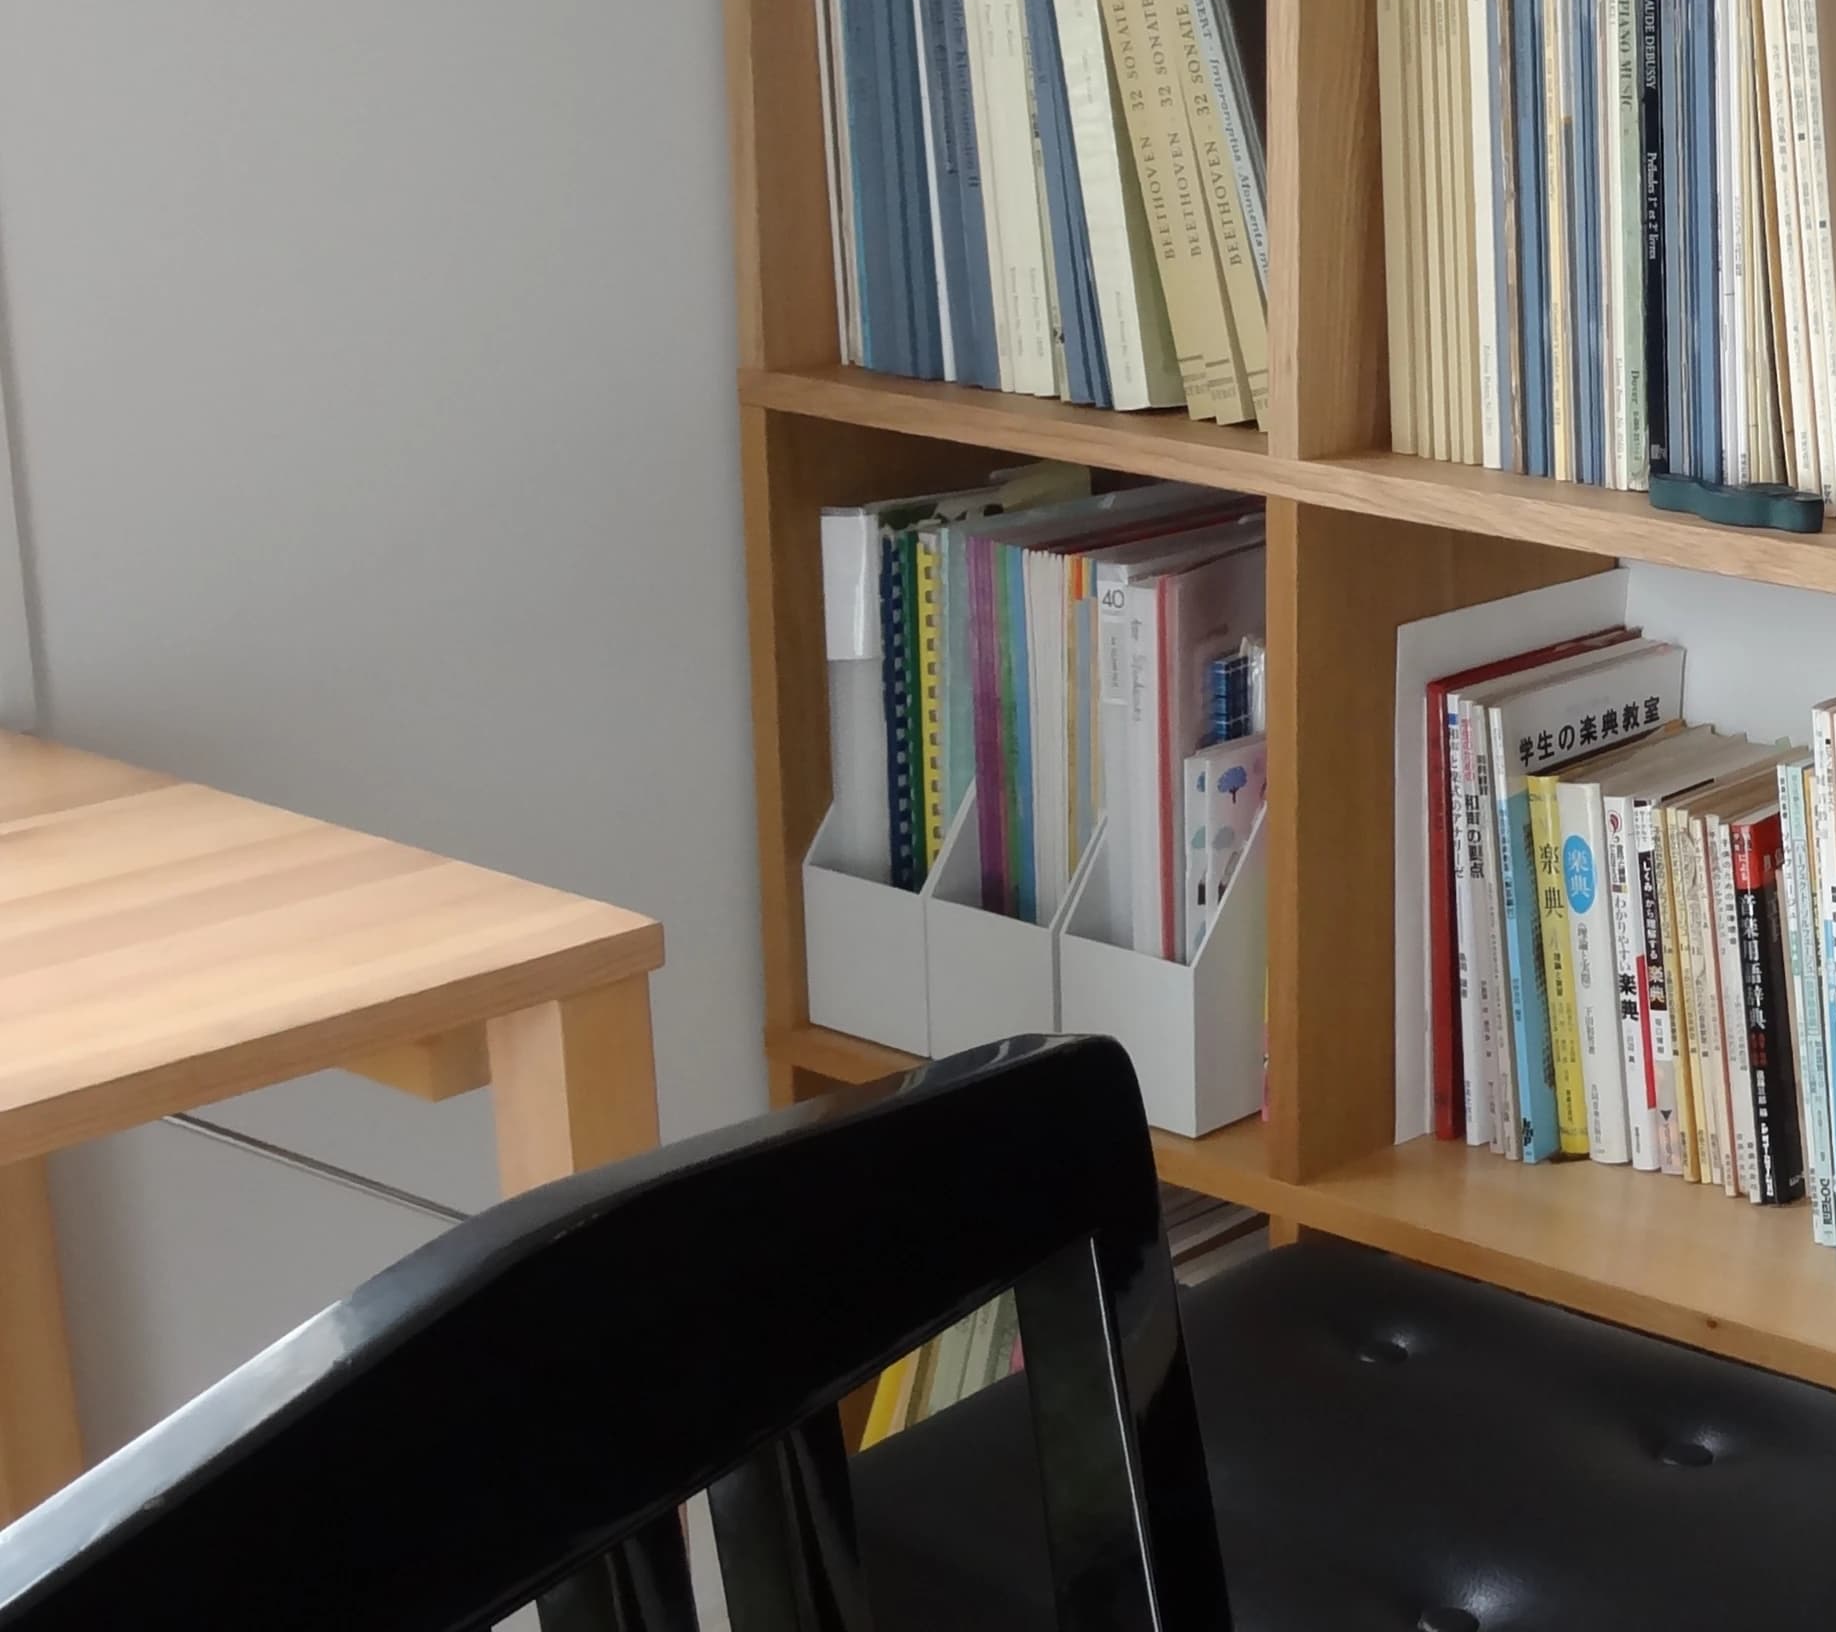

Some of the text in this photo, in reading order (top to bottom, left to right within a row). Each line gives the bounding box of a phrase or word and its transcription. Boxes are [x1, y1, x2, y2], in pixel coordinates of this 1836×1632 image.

[1618, 0, 1631, 53] PIANO
[1645, 36, 1657, 90] DEBUSSY
[1208, 58, 1242, 163] Impromptus
[1619, 57, 1633, 112] MUSIC
[1113, 1, 1176, 259] BEETHOVEN 32 SONATE
[1142, 0, 1201, 256] BEETHOVEN 32 SONATE
[1176, 5, 1243, 267] BEETHOVEN 32 SONATE
[1102, 589, 1125, 609] 40
[1519, 696, 1661, 767] 学生の楽典教室
[1539, 843, 1564, 919] 楽典
[1568, 850, 1591, 898] 楽典
[1615, 895, 1640, 1021] わかりやすい楽典
[1741, 894, 1767, 1030] 音楽用語辞典
